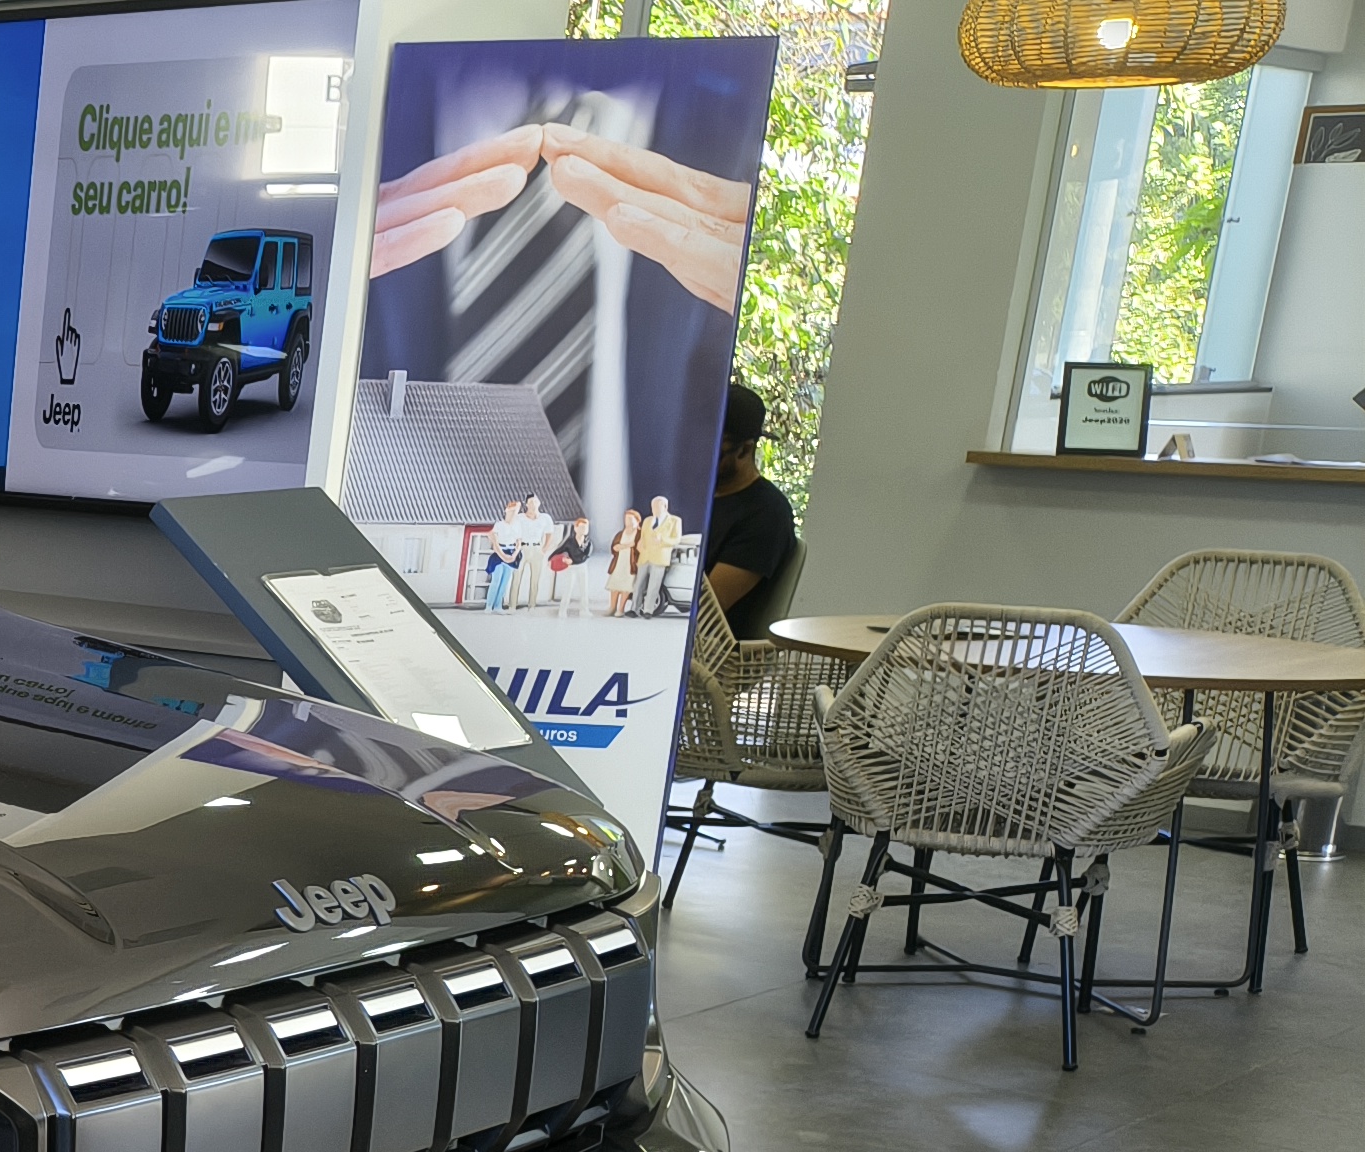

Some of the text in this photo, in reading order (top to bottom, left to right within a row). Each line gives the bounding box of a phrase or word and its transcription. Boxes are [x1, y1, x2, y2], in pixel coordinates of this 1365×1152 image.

[78, 103, 153, 162] Clique
[156, 99, 212, 160] aqui
[214, 111, 230, 147] e
[71, 167, 191, 215] seu carro!
[42, 393, 81, 433] Jeep
[486, 666, 629, 718] UILA
[539, 729, 578, 742] uros
[270, 873, 397, 933] Jeep
